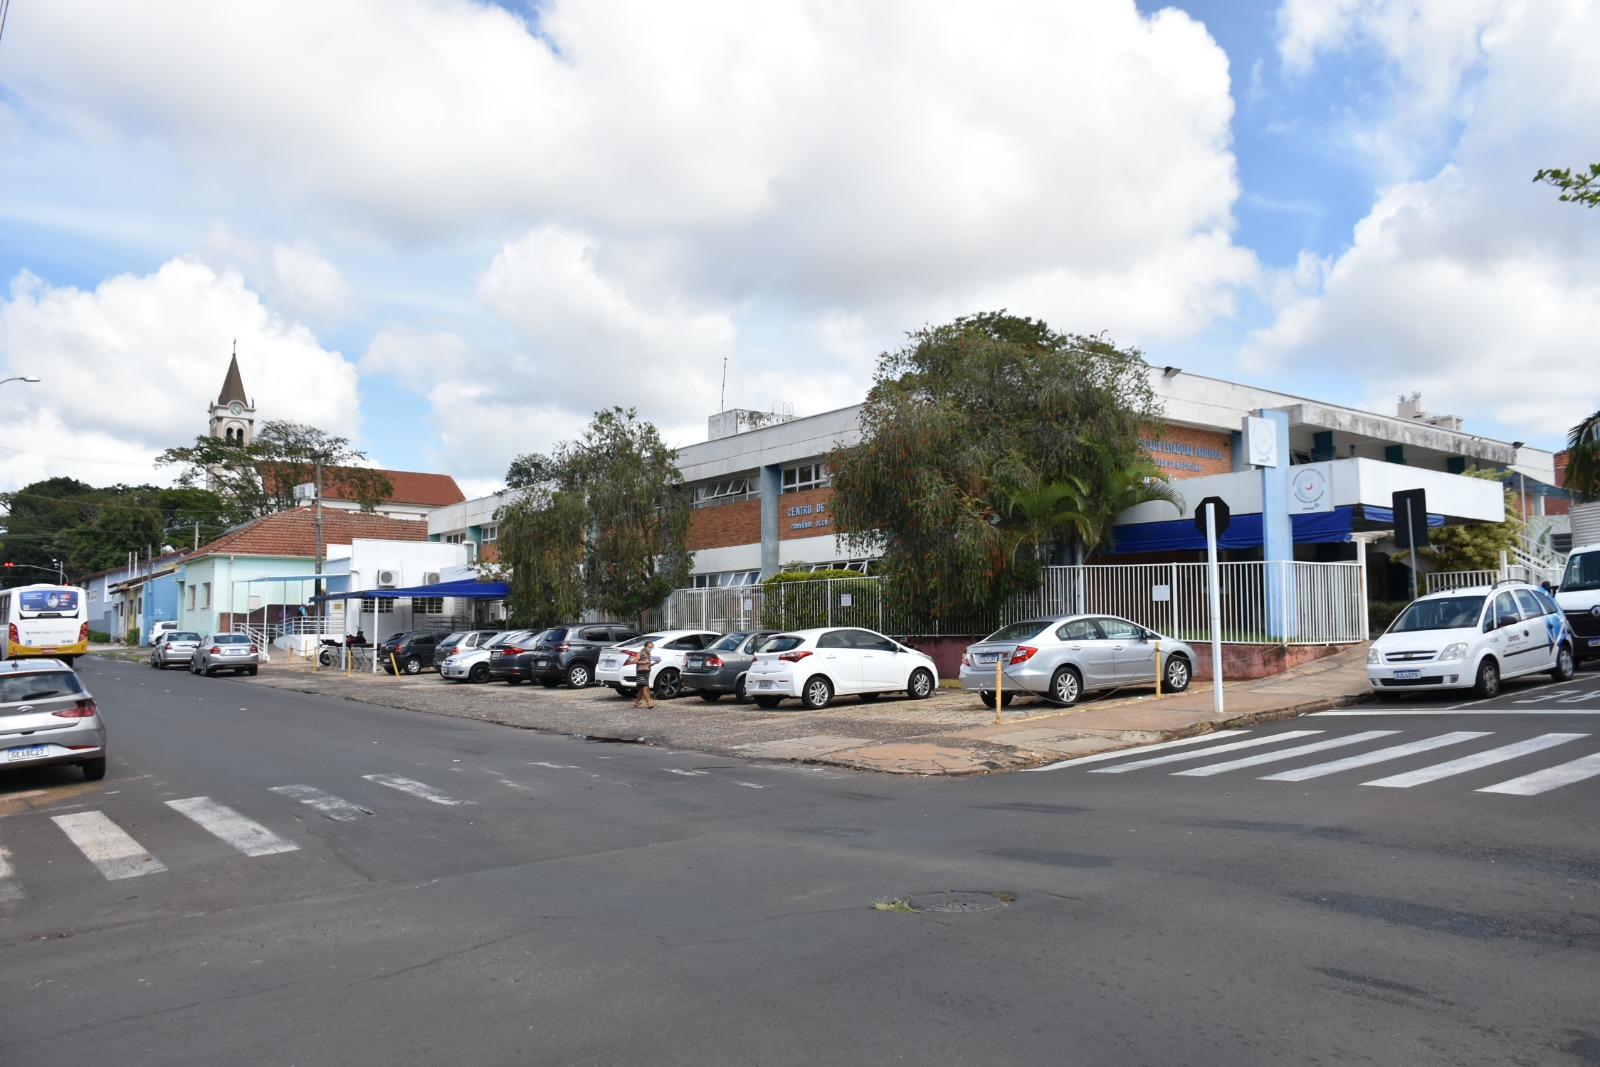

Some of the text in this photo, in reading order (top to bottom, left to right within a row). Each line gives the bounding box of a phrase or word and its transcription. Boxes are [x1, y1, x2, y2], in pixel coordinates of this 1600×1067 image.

[1163, 442, 1193, 456] ESTADUAL
[1195, 447, 1222, 460] PAULISTA
[787, 502, 825, 517] CENTRO DE
[11, 748, 45, 760] GEA8C27
